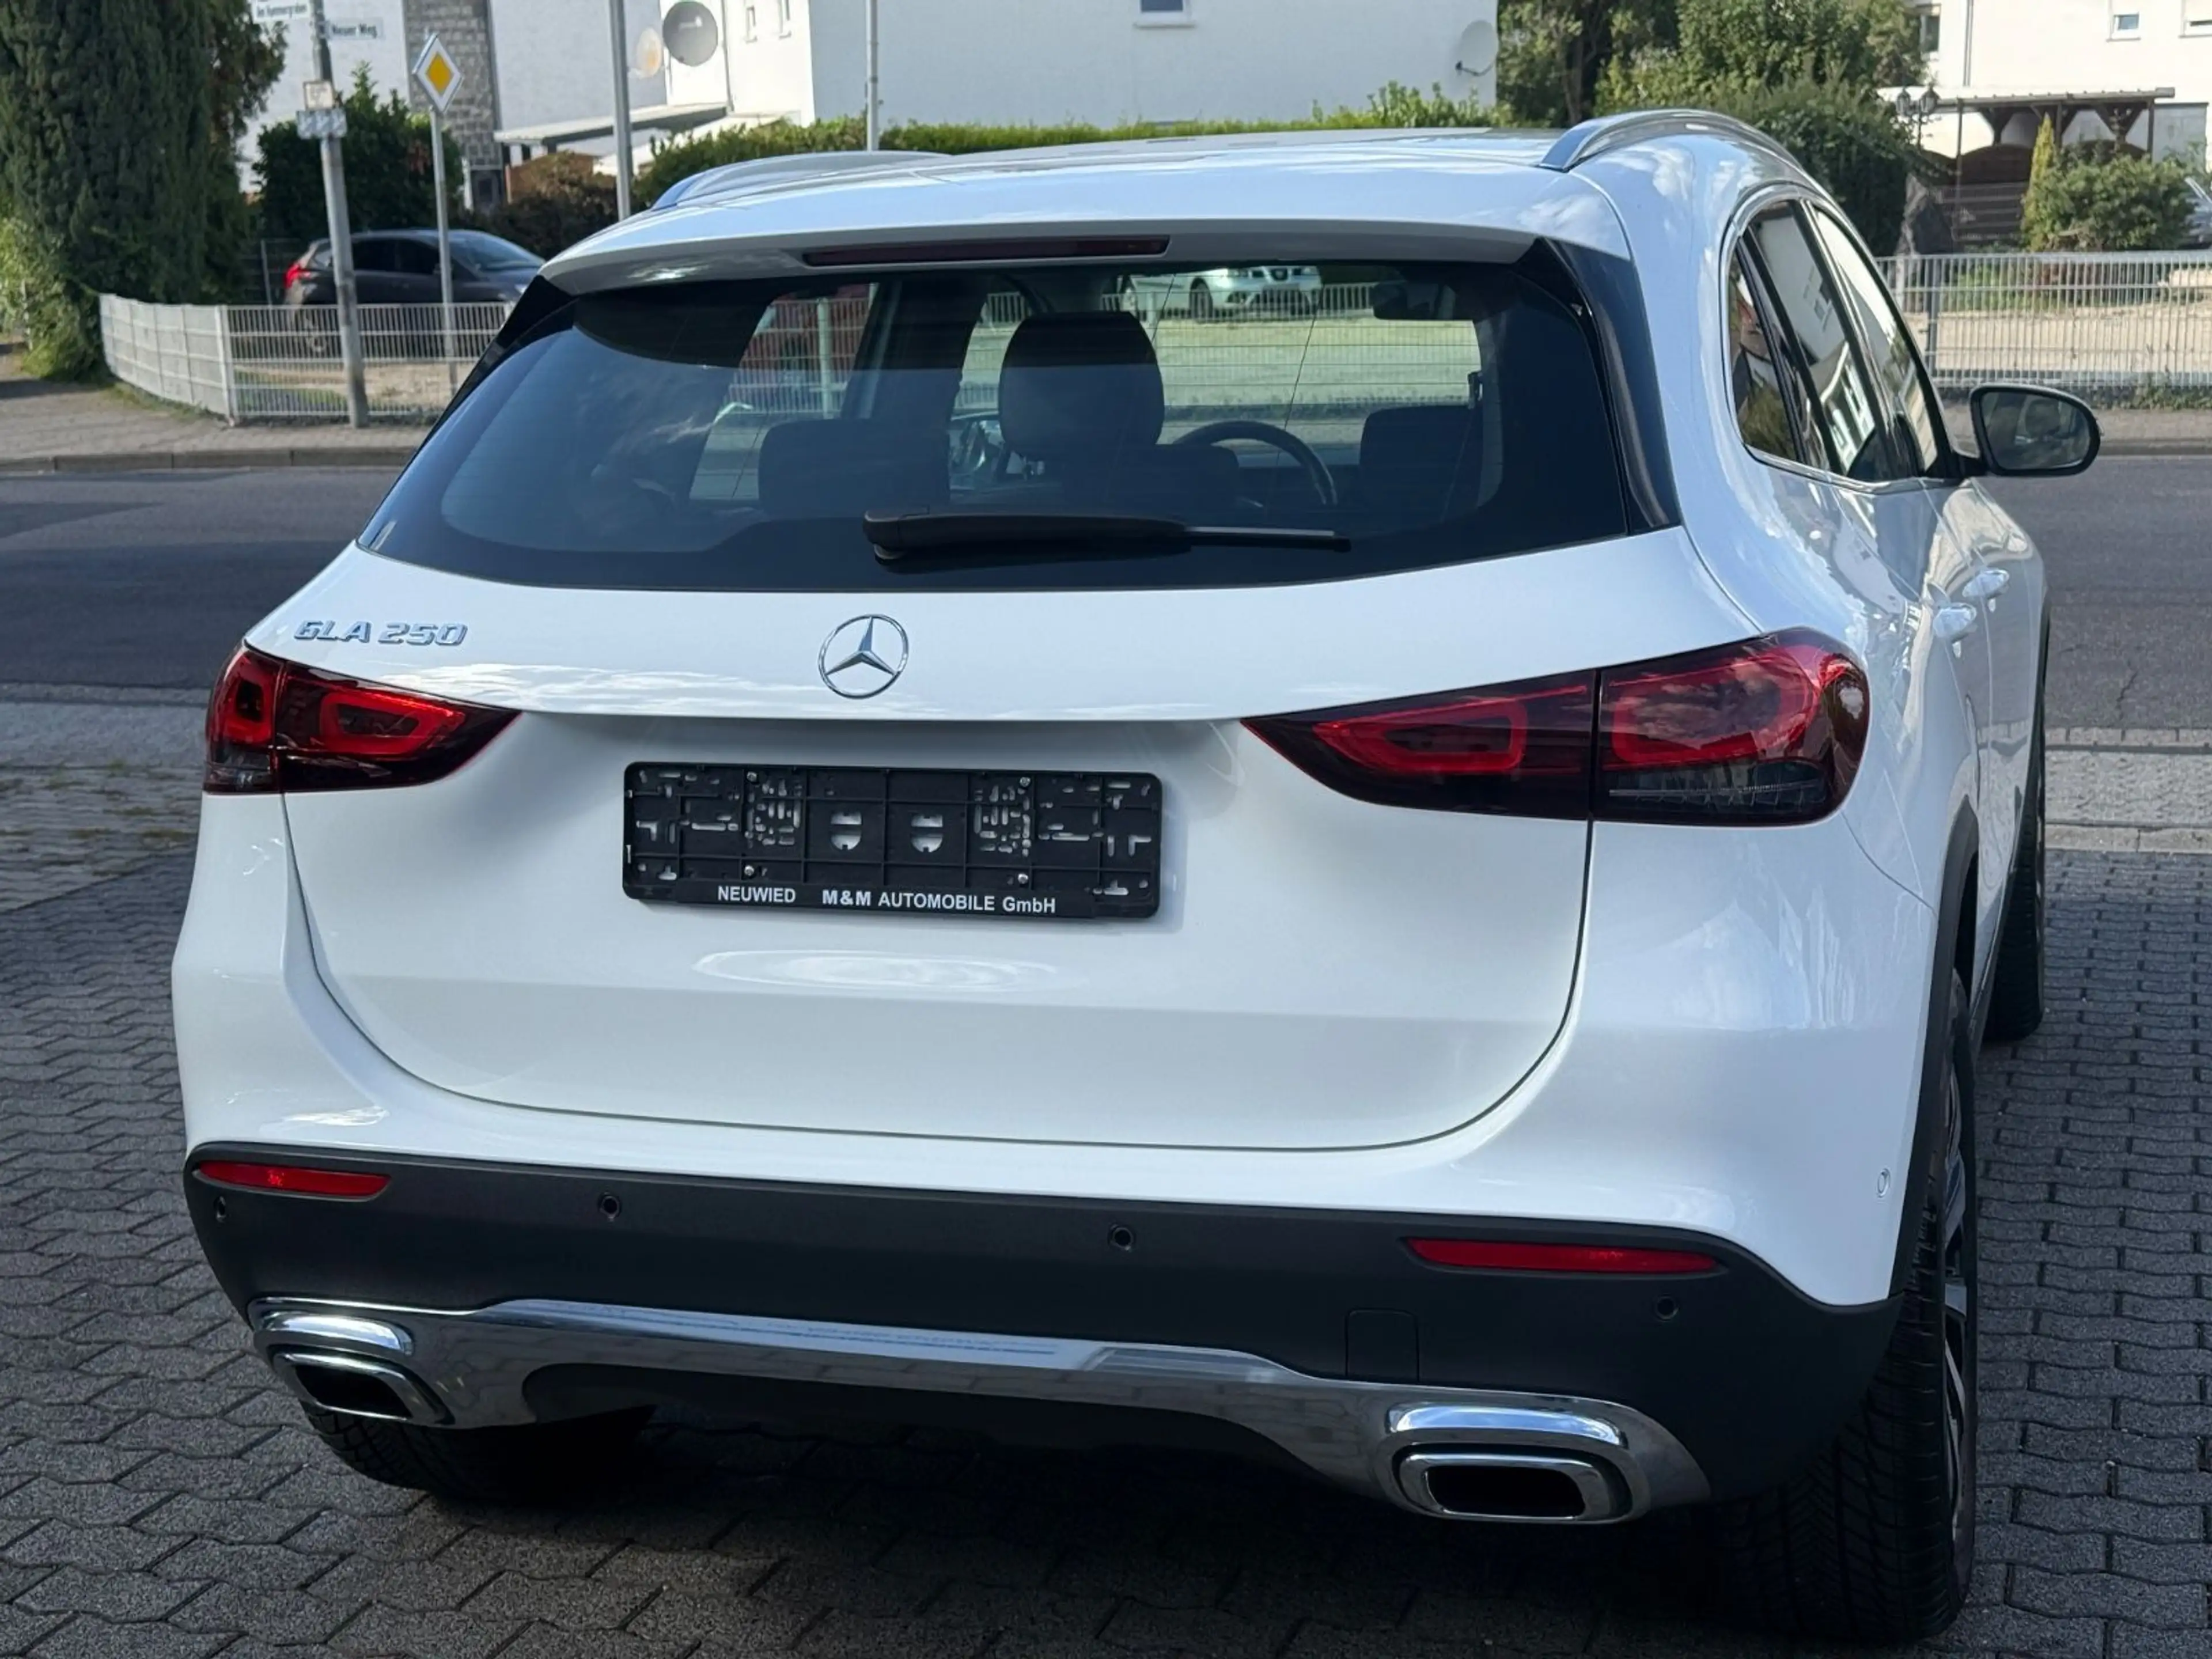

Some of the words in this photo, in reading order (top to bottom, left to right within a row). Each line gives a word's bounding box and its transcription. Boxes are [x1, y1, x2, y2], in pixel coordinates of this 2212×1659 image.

[294, 620, 372, 643] GLA
[378, 622, 468, 646] 250
[718, 886, 796, 903] NEUWIED
[822, 890, 872, 907] M&M
[878, 892, 995, 911] AUTOMOBILE
[1002, 896, 1055, 914] GmbH
